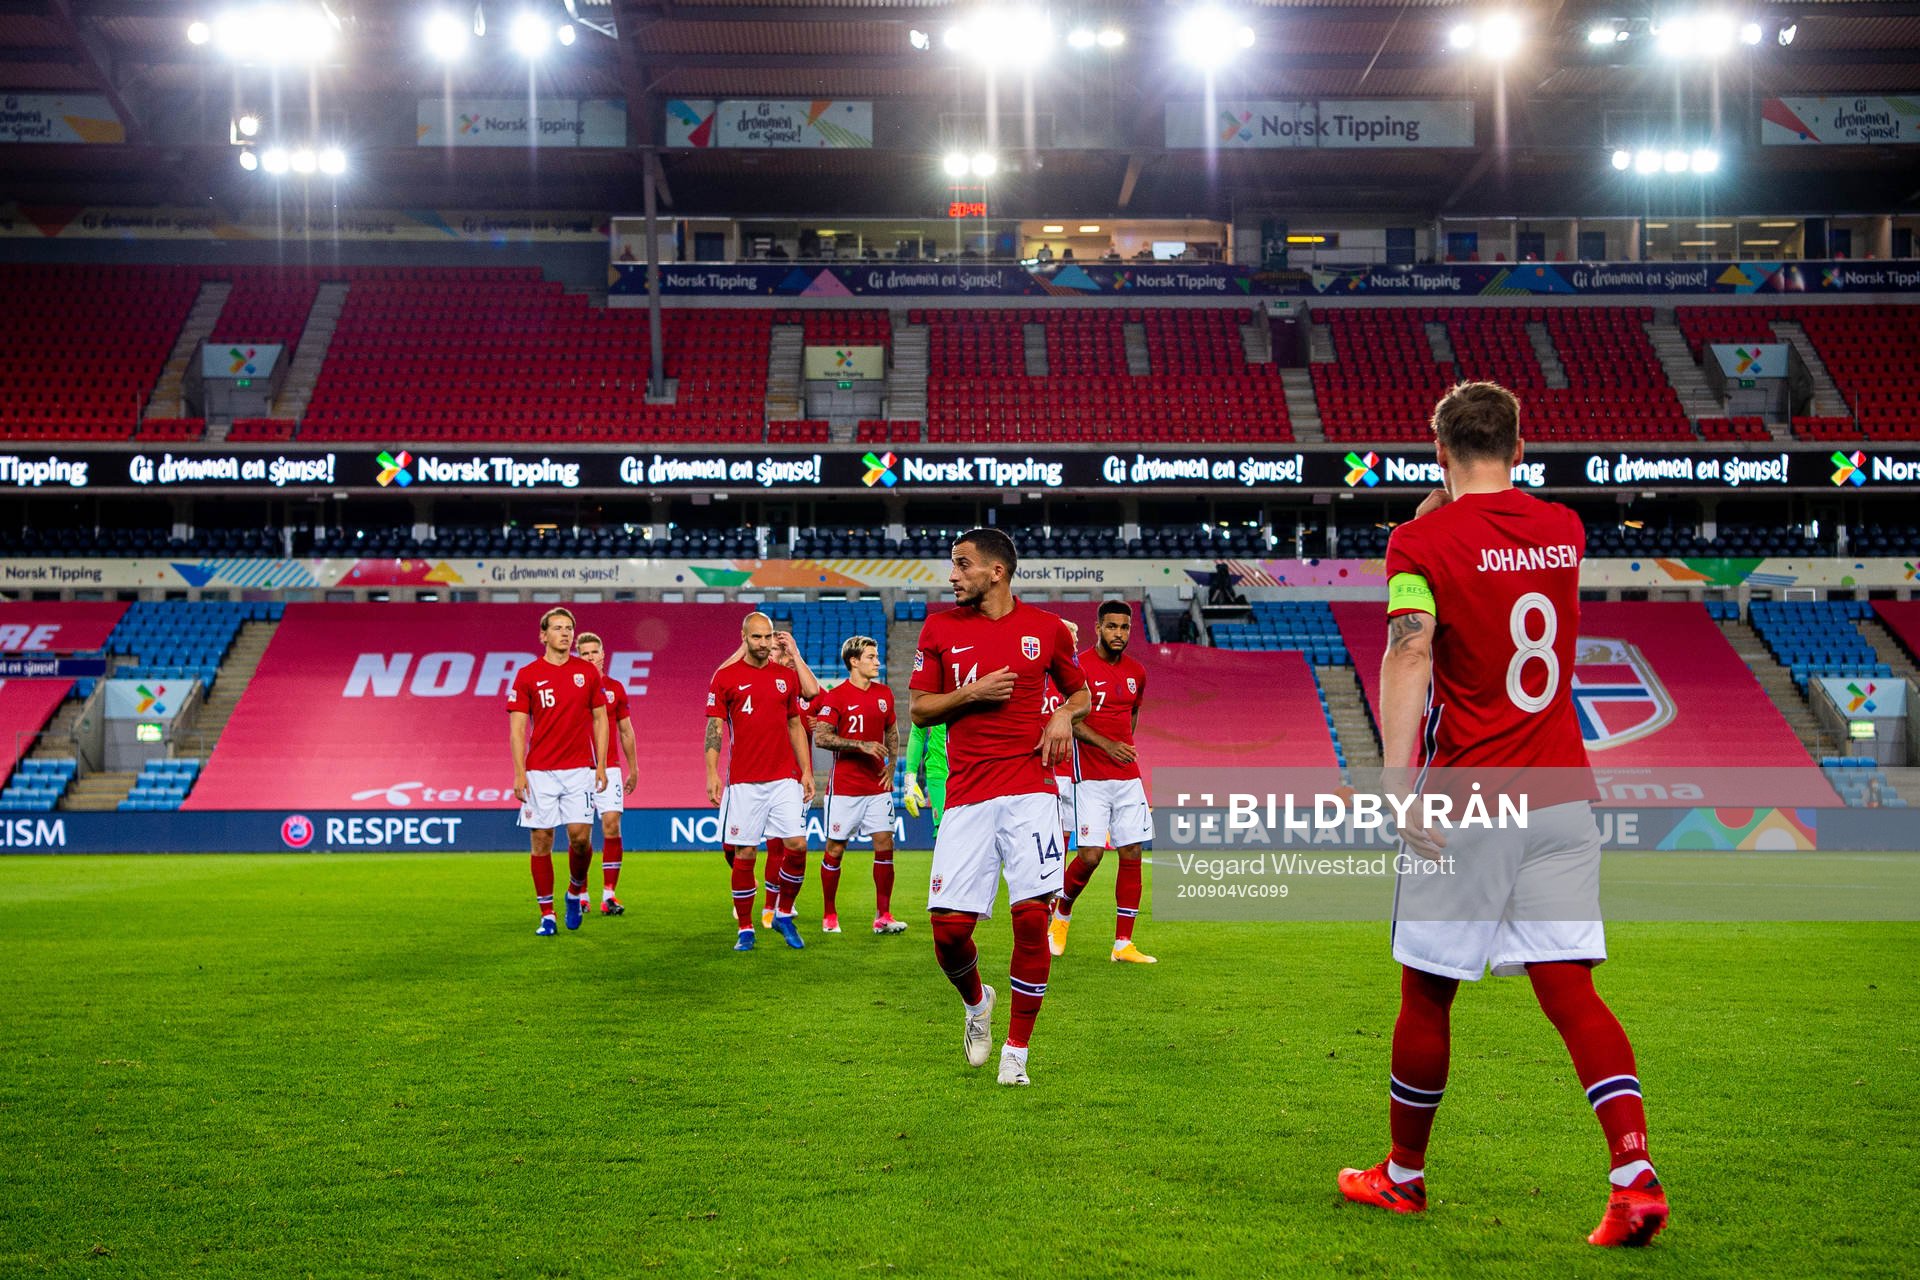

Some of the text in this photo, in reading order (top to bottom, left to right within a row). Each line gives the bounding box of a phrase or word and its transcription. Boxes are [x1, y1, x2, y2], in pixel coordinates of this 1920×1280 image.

[757, 103, 770, 117] Gi
[1854, 100, 1866, 112] Gi
[485, 117, 527, 131] Norsk
[1261, 115, 1420, 141] Norsk Tipping
[667, 273, 757, 290] Norsk Tipping
[868, 270, 1002, 291] Gi drømmen en sjanse!
[1136, 274, 1226, 290] Norsk Tipping
[1371, 274, 1461, 290] Norsk Tipping
[1573, 268, 1708, 290] Gi drømmen en sjanse!
[1845, 271, 1884, 284] Norsk
[0, 456, 87, 486] Tipping
[130, 454, 335, 486] Gi drømmen en sjanse!
[418, 457, 580, 486] Norsk Tipping
[621, 455, 821, 486] Gi drømmen en sjanse!
[904, 458, 1062, 486] Norsk Tipping
[1104, 455, 1303, 486] Gi drømmen en sjanse!
[1587, 454, 1789, 486] Gi drømmen en sjanse!
[1477, 545, 1577, 572] JOHANSEN
[5, 566, 102, 582] Norsk Tipping
[492, 565, 619, 583] Gi drømmen en sjanse!
[1053, 567, 1104, 582] Tipping
[1505, 592, 1560, 713] 8
[341, 652, 653, 697] NORE
[538, 689, 555, 708] 15
[741, 695, 754, 714] 4
[1095, 692, 1106, 712] 7
[848, 715, 864, 733] 21
[326, 817, 462, 845] RESPECT
[671, 815, 722, 844] NO
[1169, 812, 1271, 845] UEFA
[1032, 832, 1063, 865] 14
